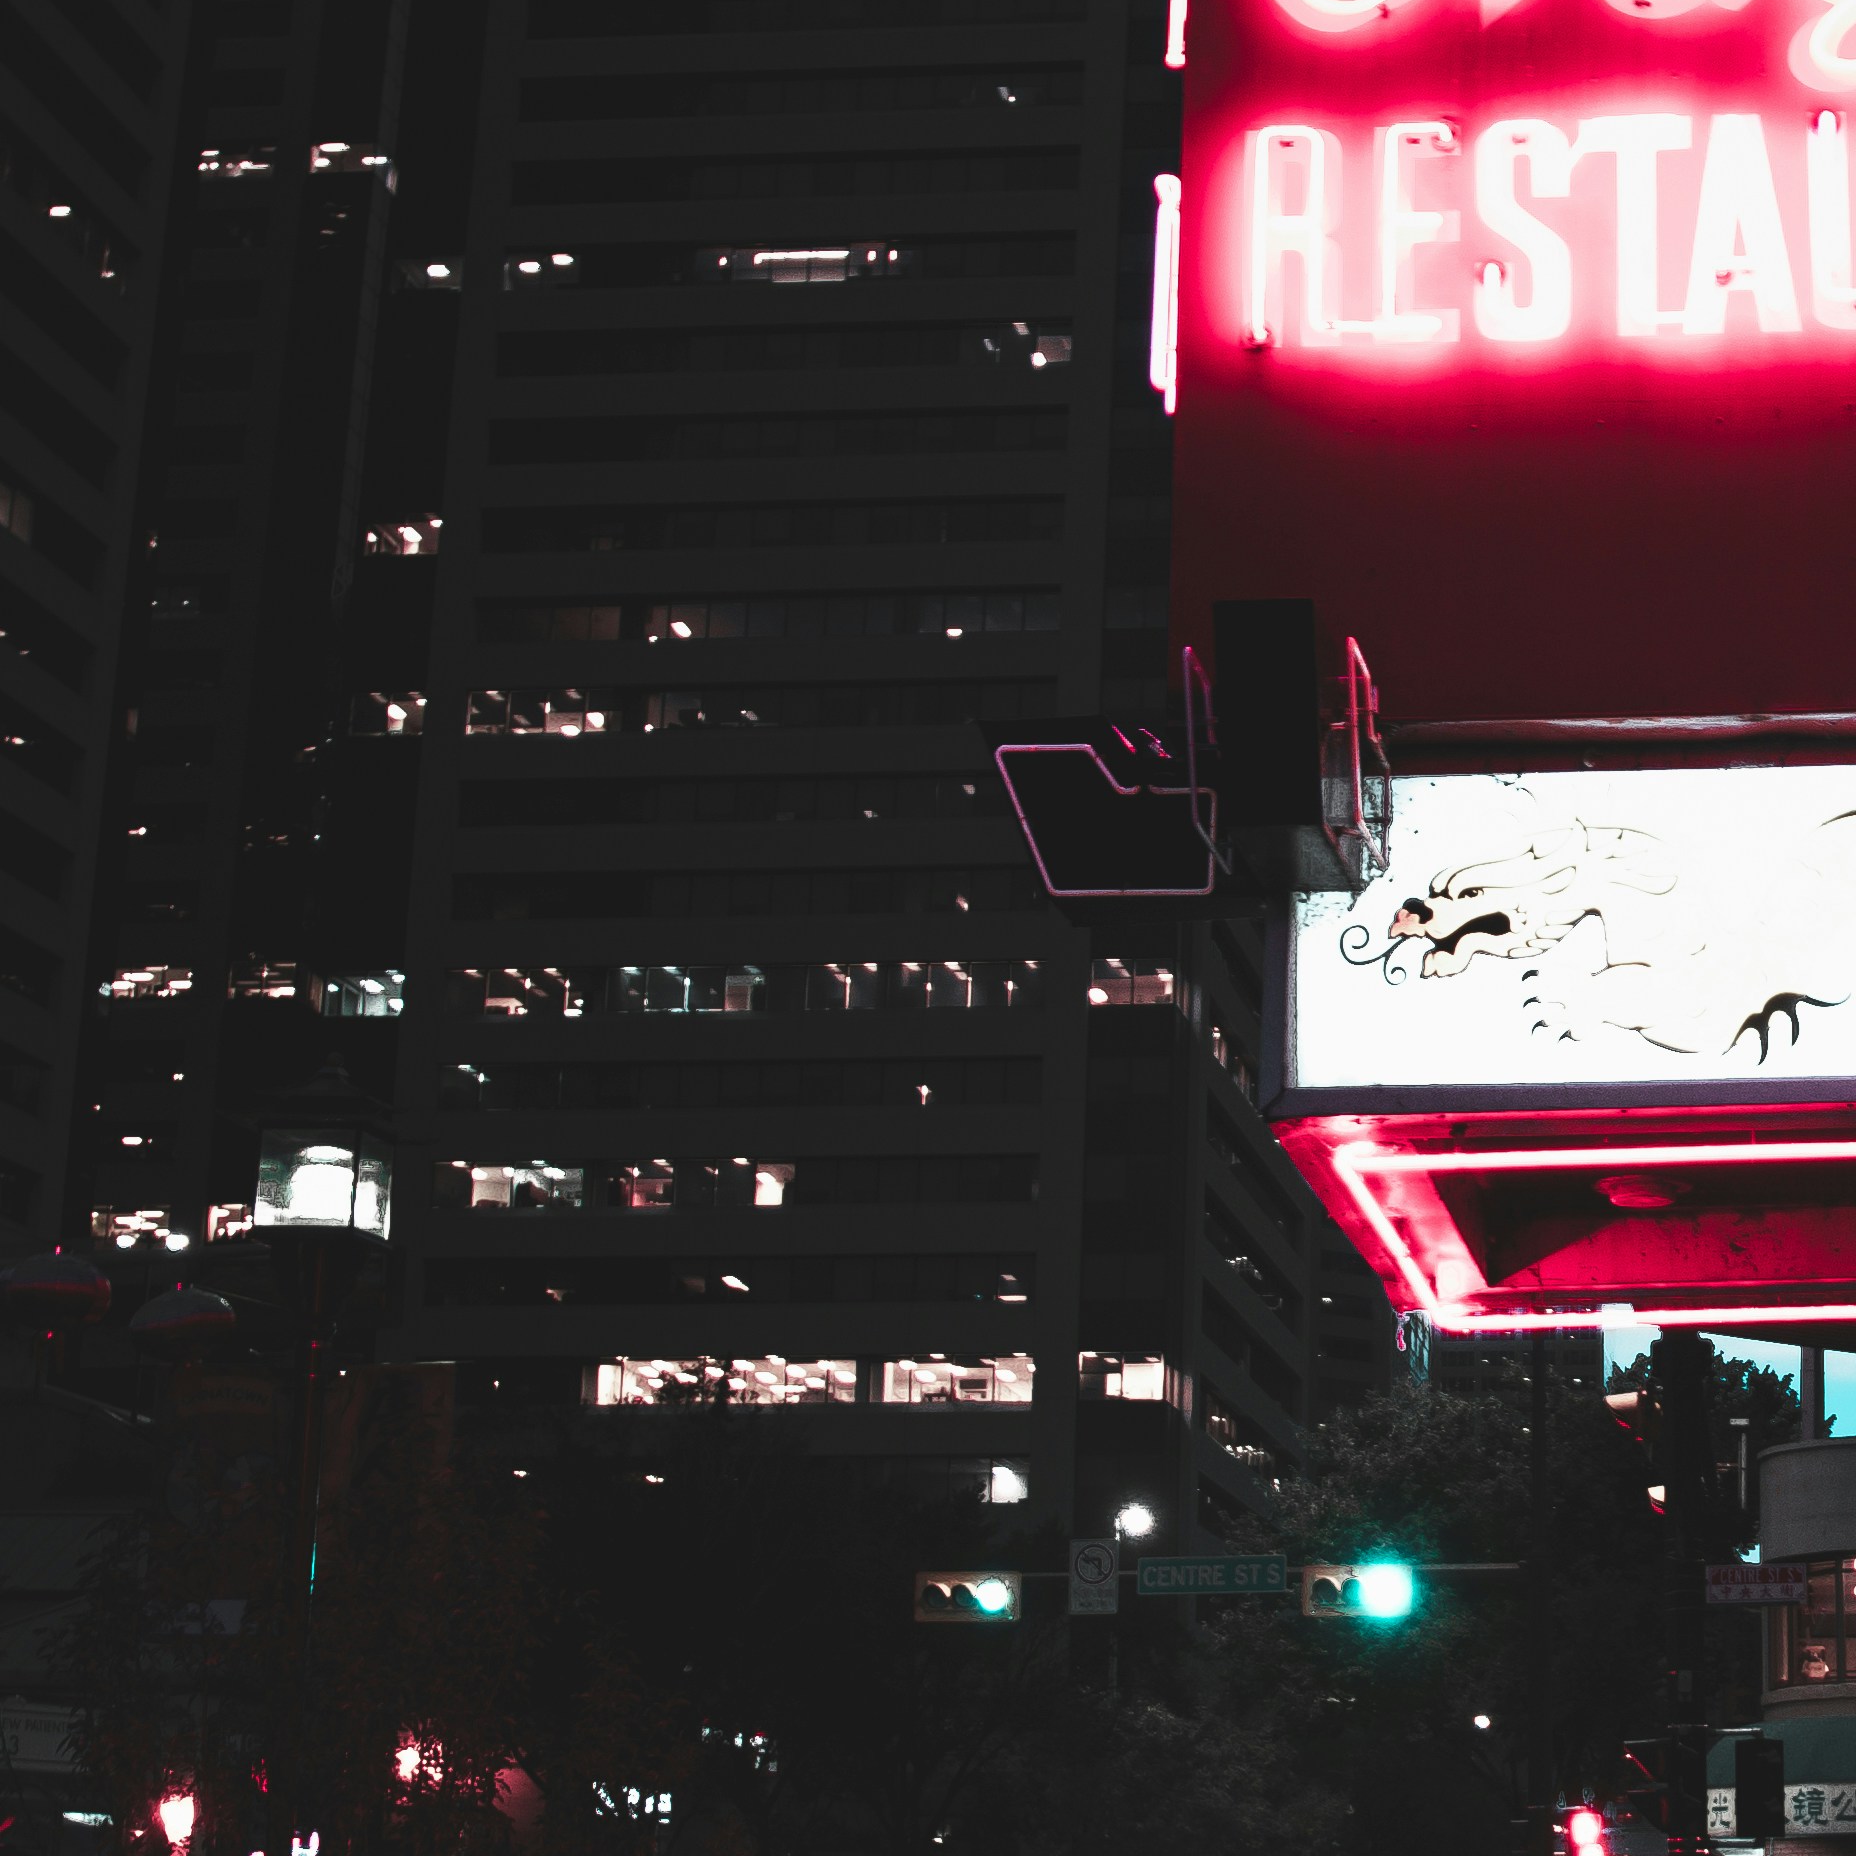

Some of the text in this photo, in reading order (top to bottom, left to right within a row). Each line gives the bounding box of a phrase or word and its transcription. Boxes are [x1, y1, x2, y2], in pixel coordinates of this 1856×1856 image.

[1142, 1562, 1281, 1588] CENTRE ST S
[1719, 1567, 1762, 1584] CENTRE
[1767, 1566, 1780, 1584] ST
